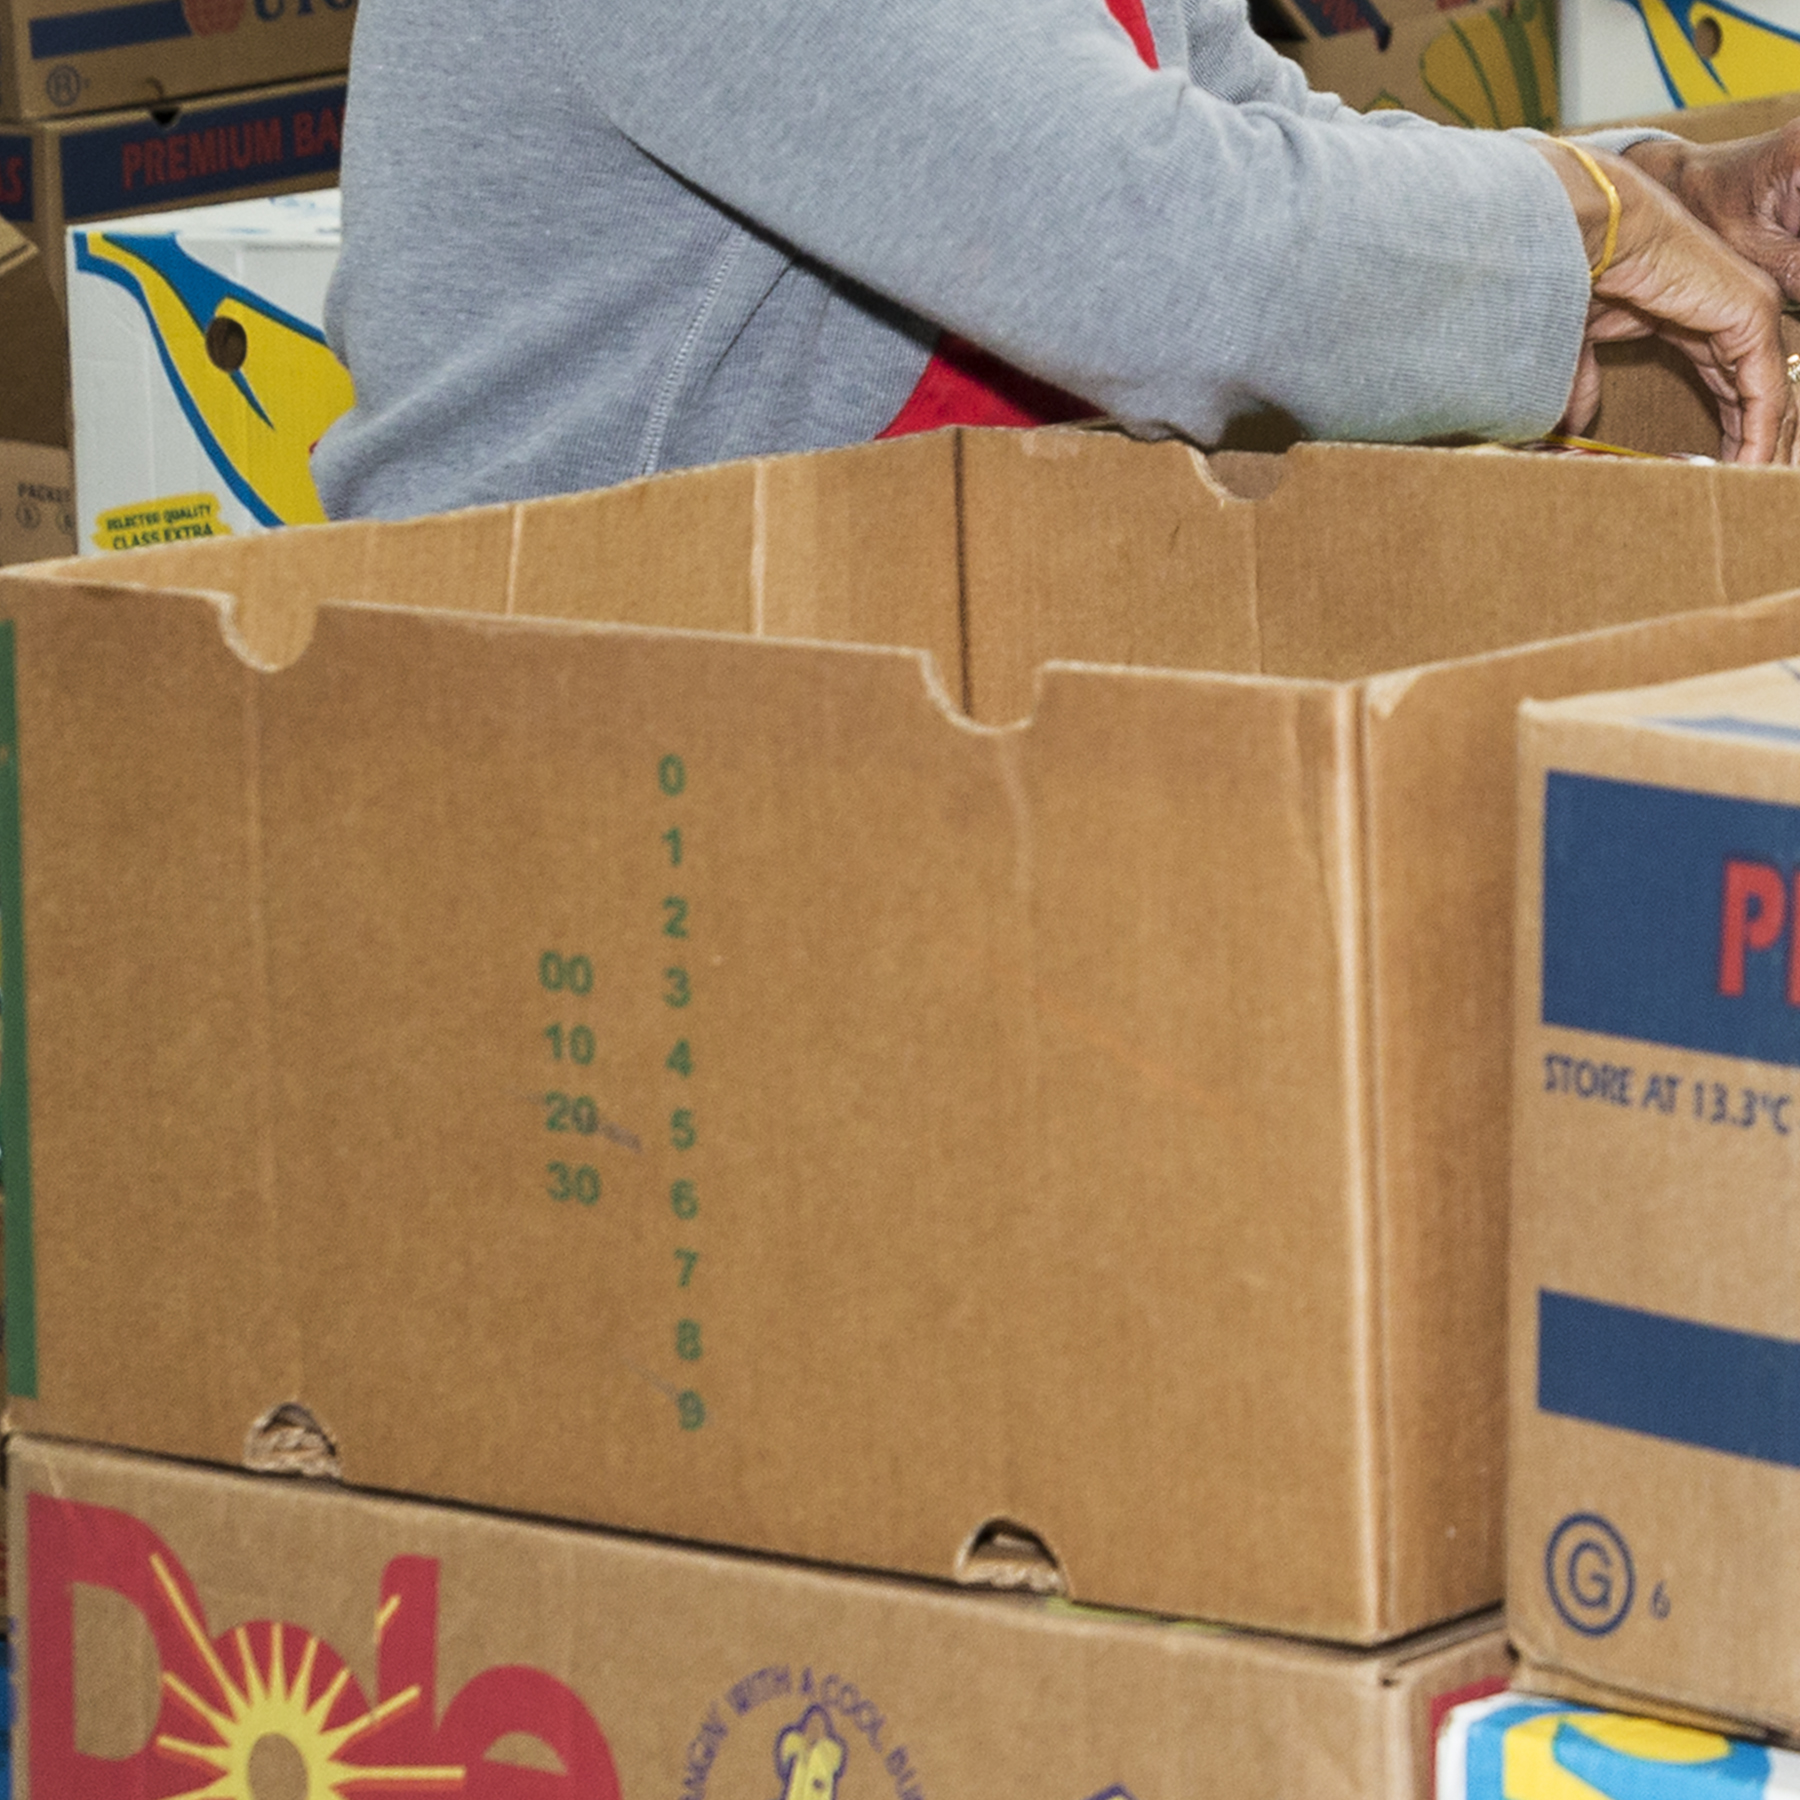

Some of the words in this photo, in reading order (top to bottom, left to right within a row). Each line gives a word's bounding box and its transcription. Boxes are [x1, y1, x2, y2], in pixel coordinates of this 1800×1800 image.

[120, 115, 284, 192] PREMIUM
[293, 104, 346, 159] BA
[162, 502, 213, 525] QUALITY
[112, 527, 161, 551] CLASS
[163, 521, 214, 544] EXTRA
[658, 753, 687, 797] 0
[661, 825, 683, 868] 1
[661, 896, 690, 940] 2
[538, 948, 595, 997] 00
[662, 965, 693, 1009] 3
[543, 1022, 597, 1066] 10
[664, 1038, 694, 1079] 4
[544, 1090, 599, 1136] 20
[1543, 1051, 1634, 1108] STORE
[1641, 1071, 1680, 1116] AT
[1694, 1080, 1791, 1136] 13.3°C
[669, 1108, 697, 1152] 5
[546, 1159, 601, 1207] 30
[669, 1178, 699, 1222] 6
[672, 1248, 699, 1290] 7
